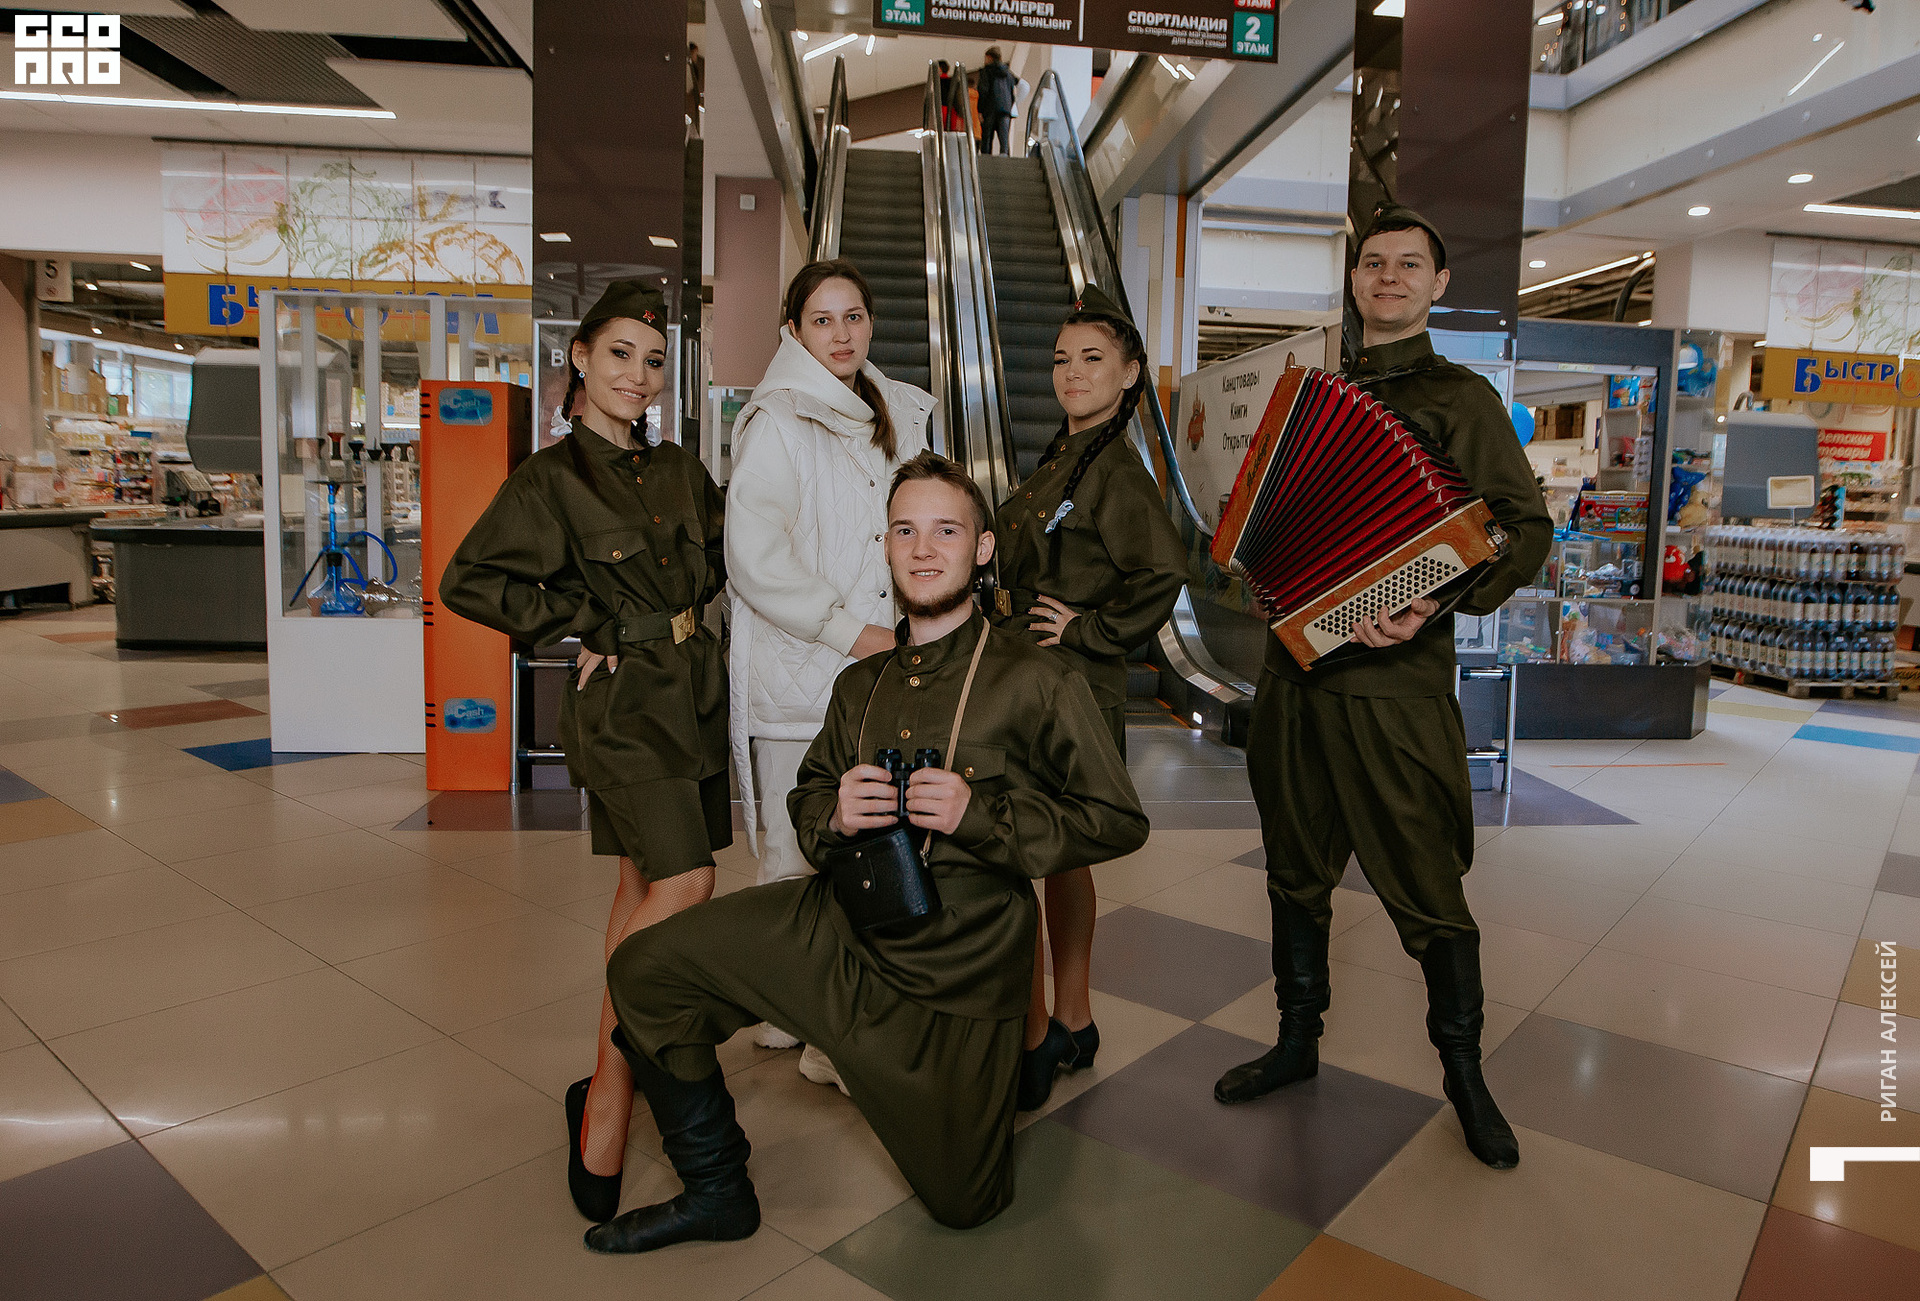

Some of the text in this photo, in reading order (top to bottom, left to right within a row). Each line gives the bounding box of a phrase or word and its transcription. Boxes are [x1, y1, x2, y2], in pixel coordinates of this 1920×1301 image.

[885, 8, 921, 24] ЭТАЖ
[931, 6, 1072, 30] САЛОН КРАСОТЫ, SUNLIGHT
[994, 0, 1055, 17] ГАЛЕРЕЯ
[1127, 11, 1228, 32] СПОРТЛАНДИЯ
[1245, 16, 1260, 41] 2
[1236, 41, 1270, 55] ЭТАЖ
[44, 260, 58, 279] 5
[1222, 370, 1260, 394] Канцтовары
[1794, 357, 1920, 398] БЫСТР
[1230, 402, 1248, 421] Книги
